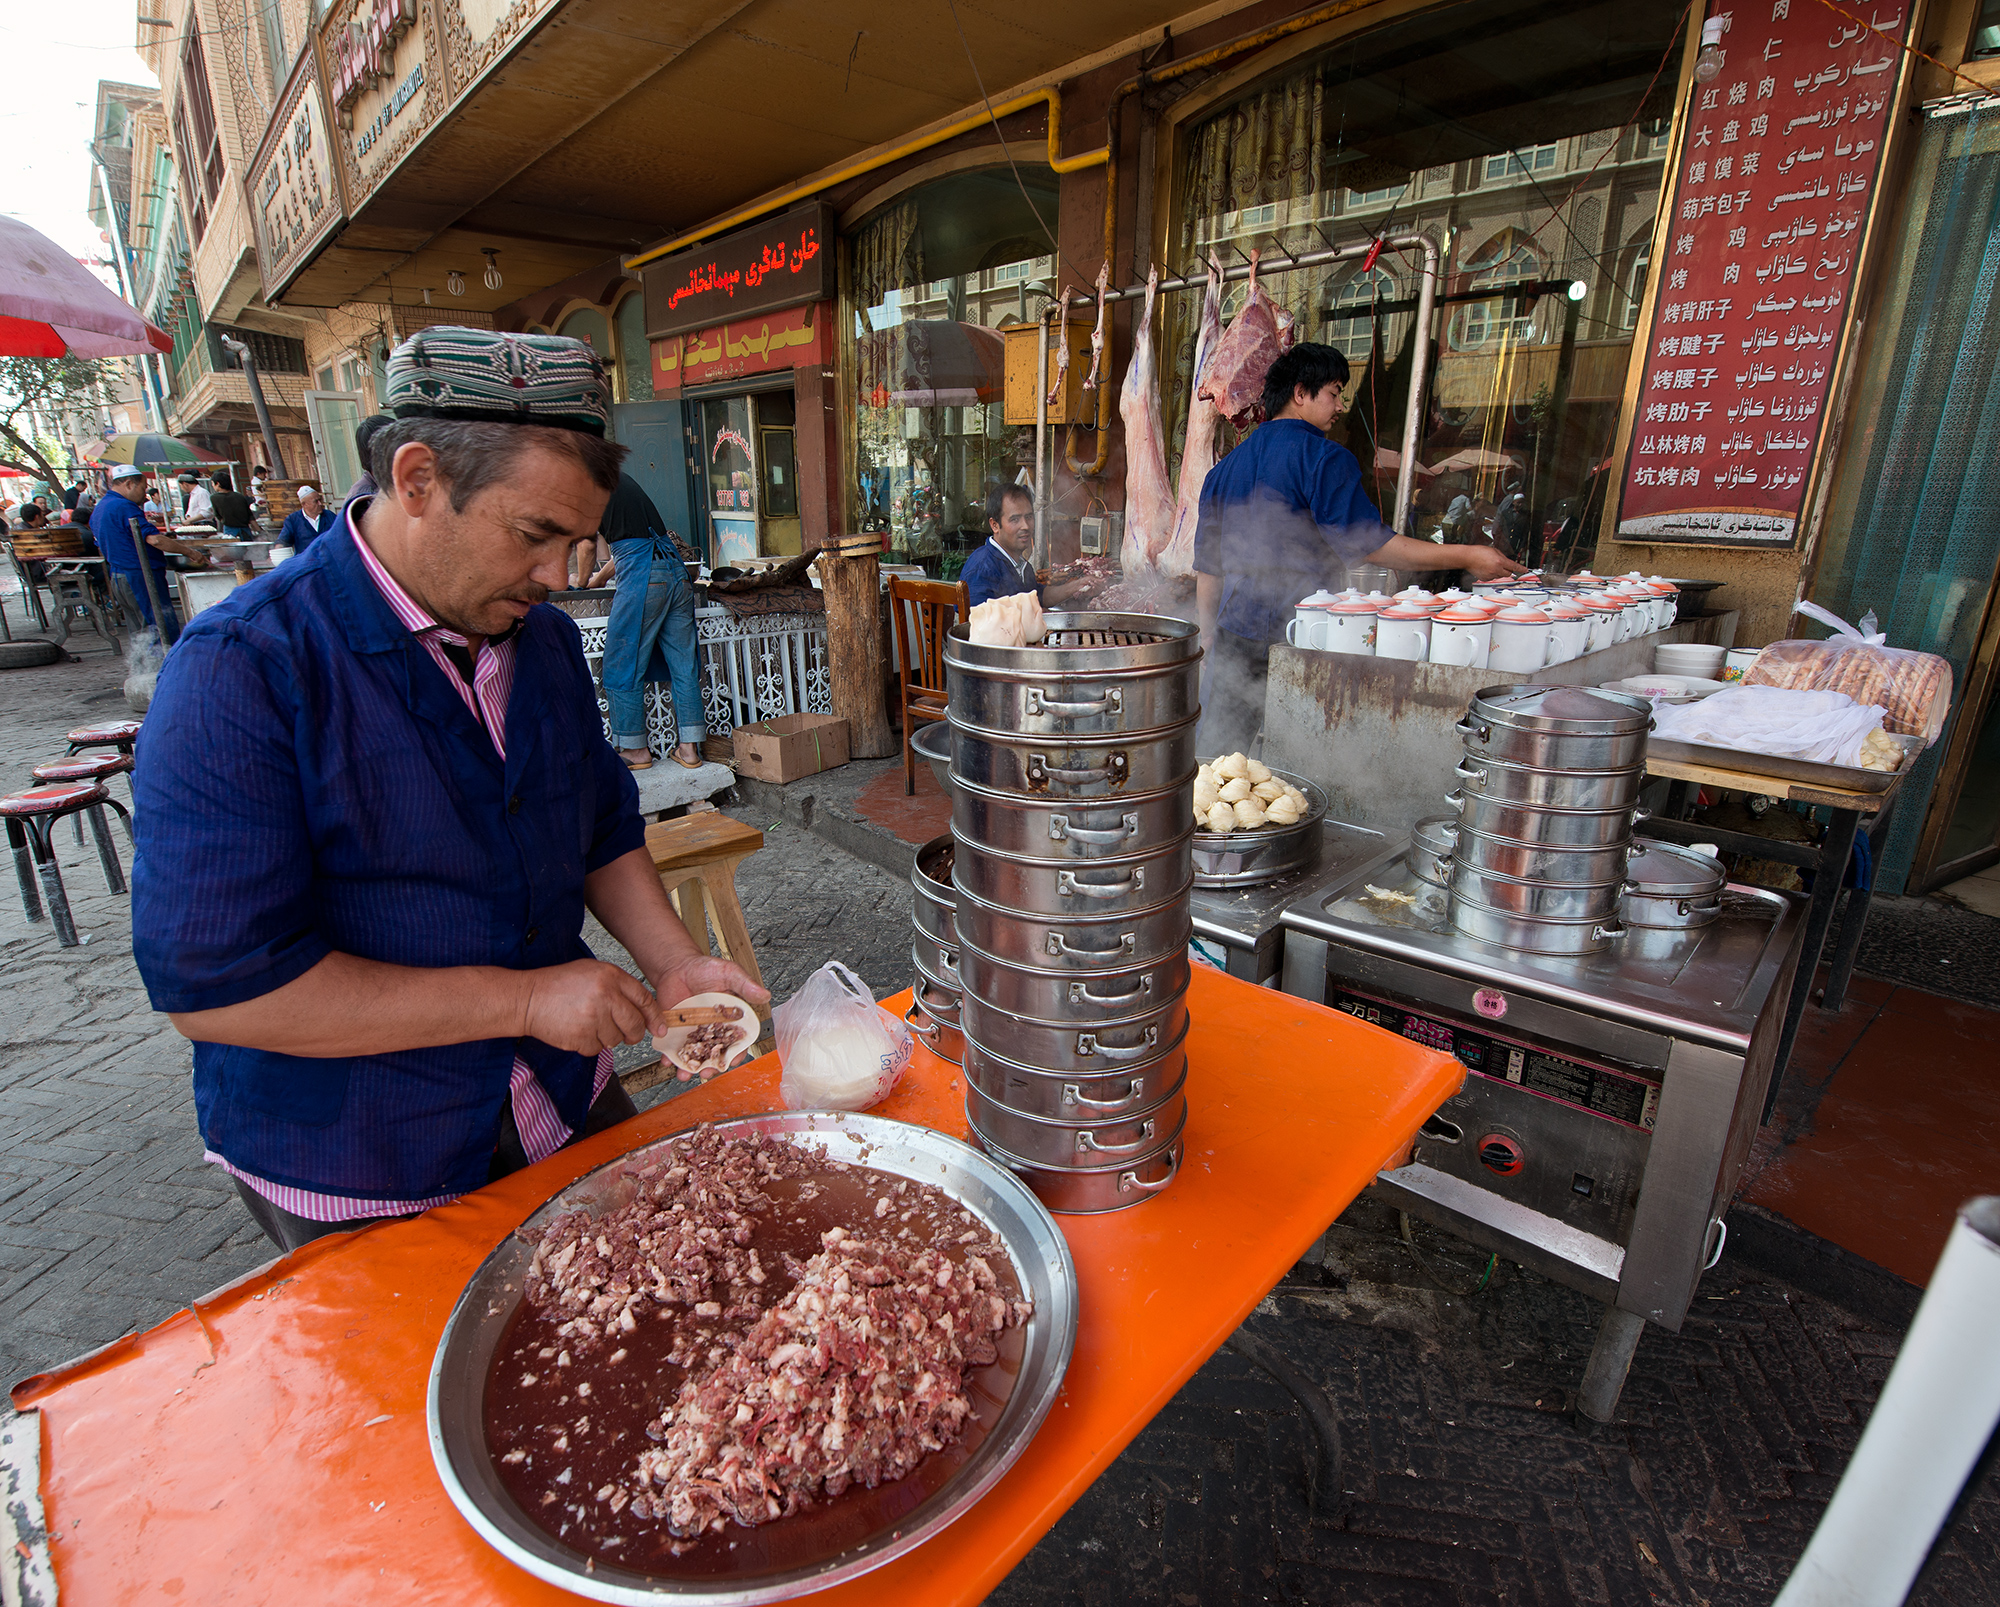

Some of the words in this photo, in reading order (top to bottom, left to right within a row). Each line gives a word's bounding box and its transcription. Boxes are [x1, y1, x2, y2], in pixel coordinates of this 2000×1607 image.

[1701, 75, 1776, 111] 红烧肉
[1693, 113, 1769, 149] 大盘鸡
[1834, 134, 1875, 161] موما
[1688, 152, 1761, 184] 馍馍菜
[1682, 190, 1752, 220] 葫芦包子
[1675, 226, 1748, 255] 烤鸡
[1668, 262, 1741, 290] 烤肉
[1755, 253, 1808, 285] كاۋاپ
[1662, 298, 1733, 324] 烤背肝子
[1741, 327, 1779, 355] كاۋاپ
[1651, 367, 1719, 390] 烤腰子
[1735, 362, 1777, 390] كاۋاپ
[1645, 401, 1713, 423] 烤肋子
[1727, 396, 1766, 424] كاۋاپ
[1639, 434, 1707, 454] 丛林烤肉
[1720, 431, 1754, 457] كاۋاپ
[1634, 466, 1701, 487] 坑烤肉
[1714, 464, 1758, 490] كاۋاپ
[1403, 1015, 1454, 1044] 365天
